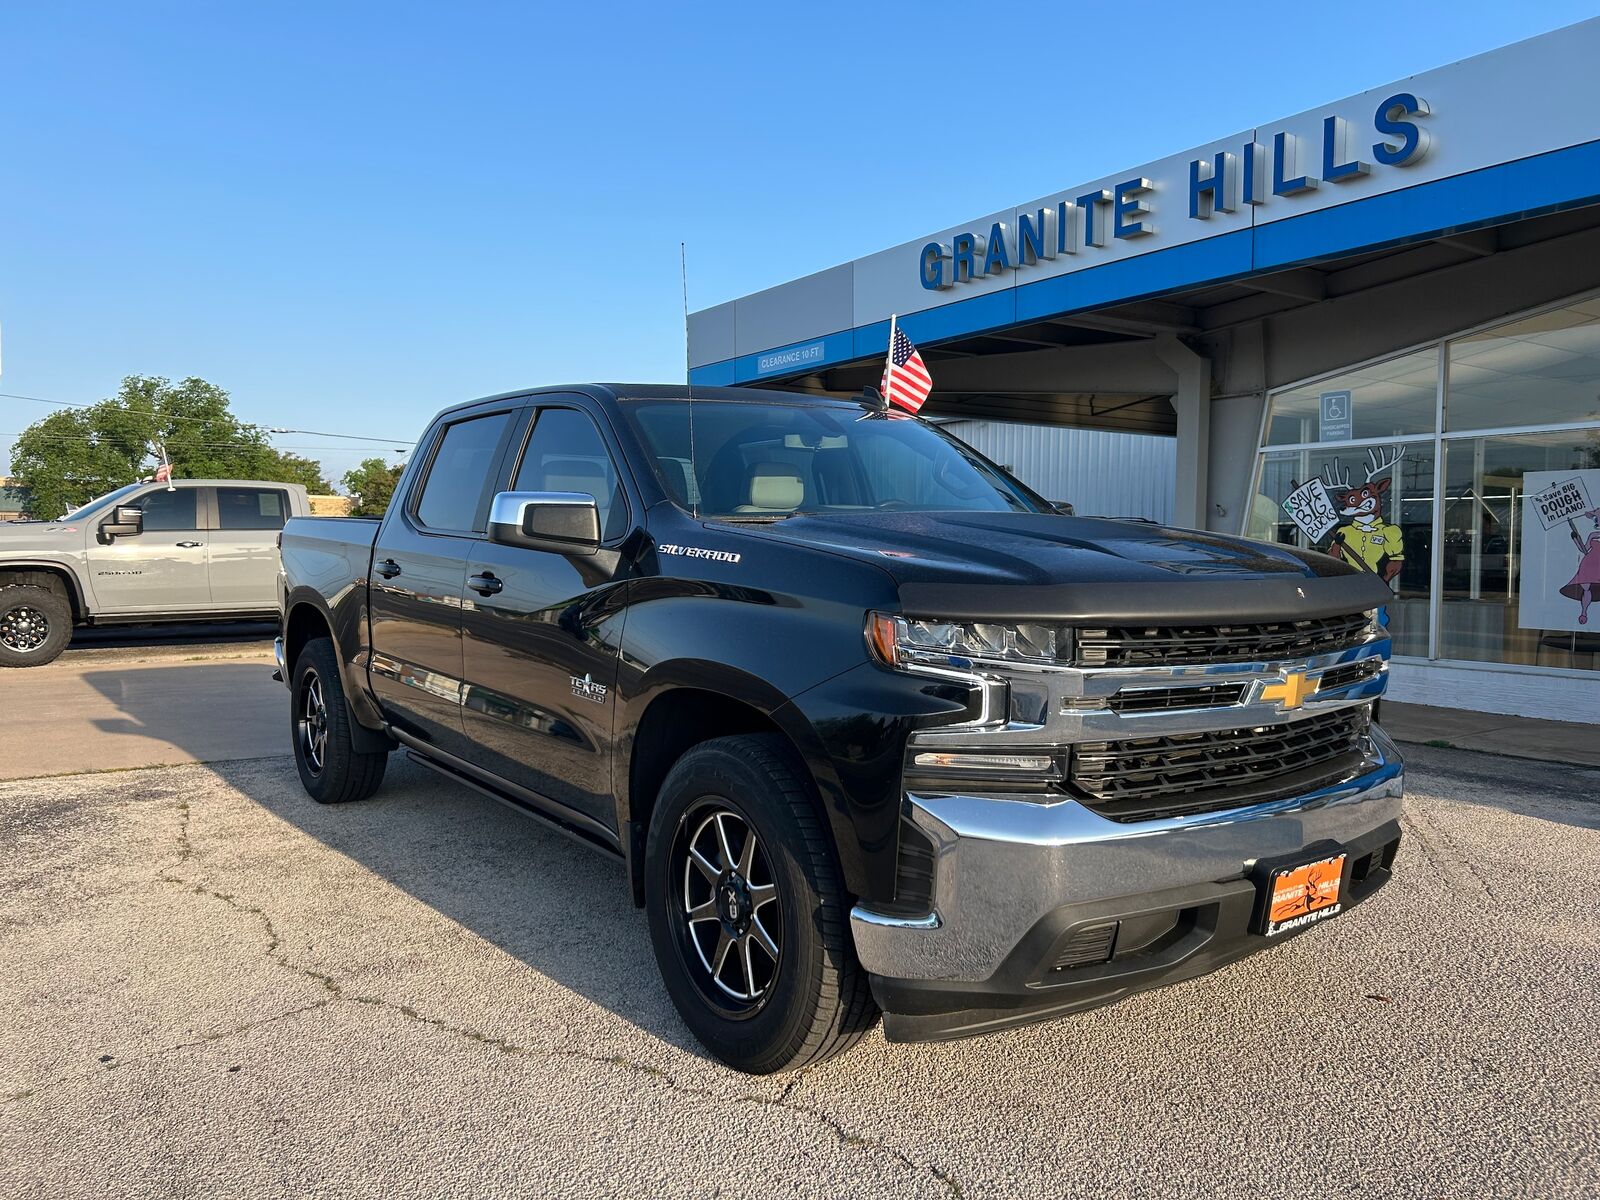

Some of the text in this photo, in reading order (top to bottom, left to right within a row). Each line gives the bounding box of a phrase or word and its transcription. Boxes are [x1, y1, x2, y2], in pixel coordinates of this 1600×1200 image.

[920, 92, 1431, 291] GRANITE HILLS
[761, 346, 820, 369] CLEARANCE 10 FT
[1290, 481, 1322, 510] SAVE
[1541, 490, 1582, 516] DOUGH
[1543, 490, 1562, 502] Save
[1562, 483, 1576, 494] BIG
[1296, 497, 1327, 526] BIG
[1547, 514, 1556, 522] in
[1555, 500, 1587, 519] LLANO!
[1306, 508, 1338, 539] BUCKS
[658, 544, 741, 563] SILVERADO
[570, 673, 607, 695] TEXAS
[1318, 878, 1341, 889] HILLS
[1279, 903, 1341, 932] GRANITE HILLS
